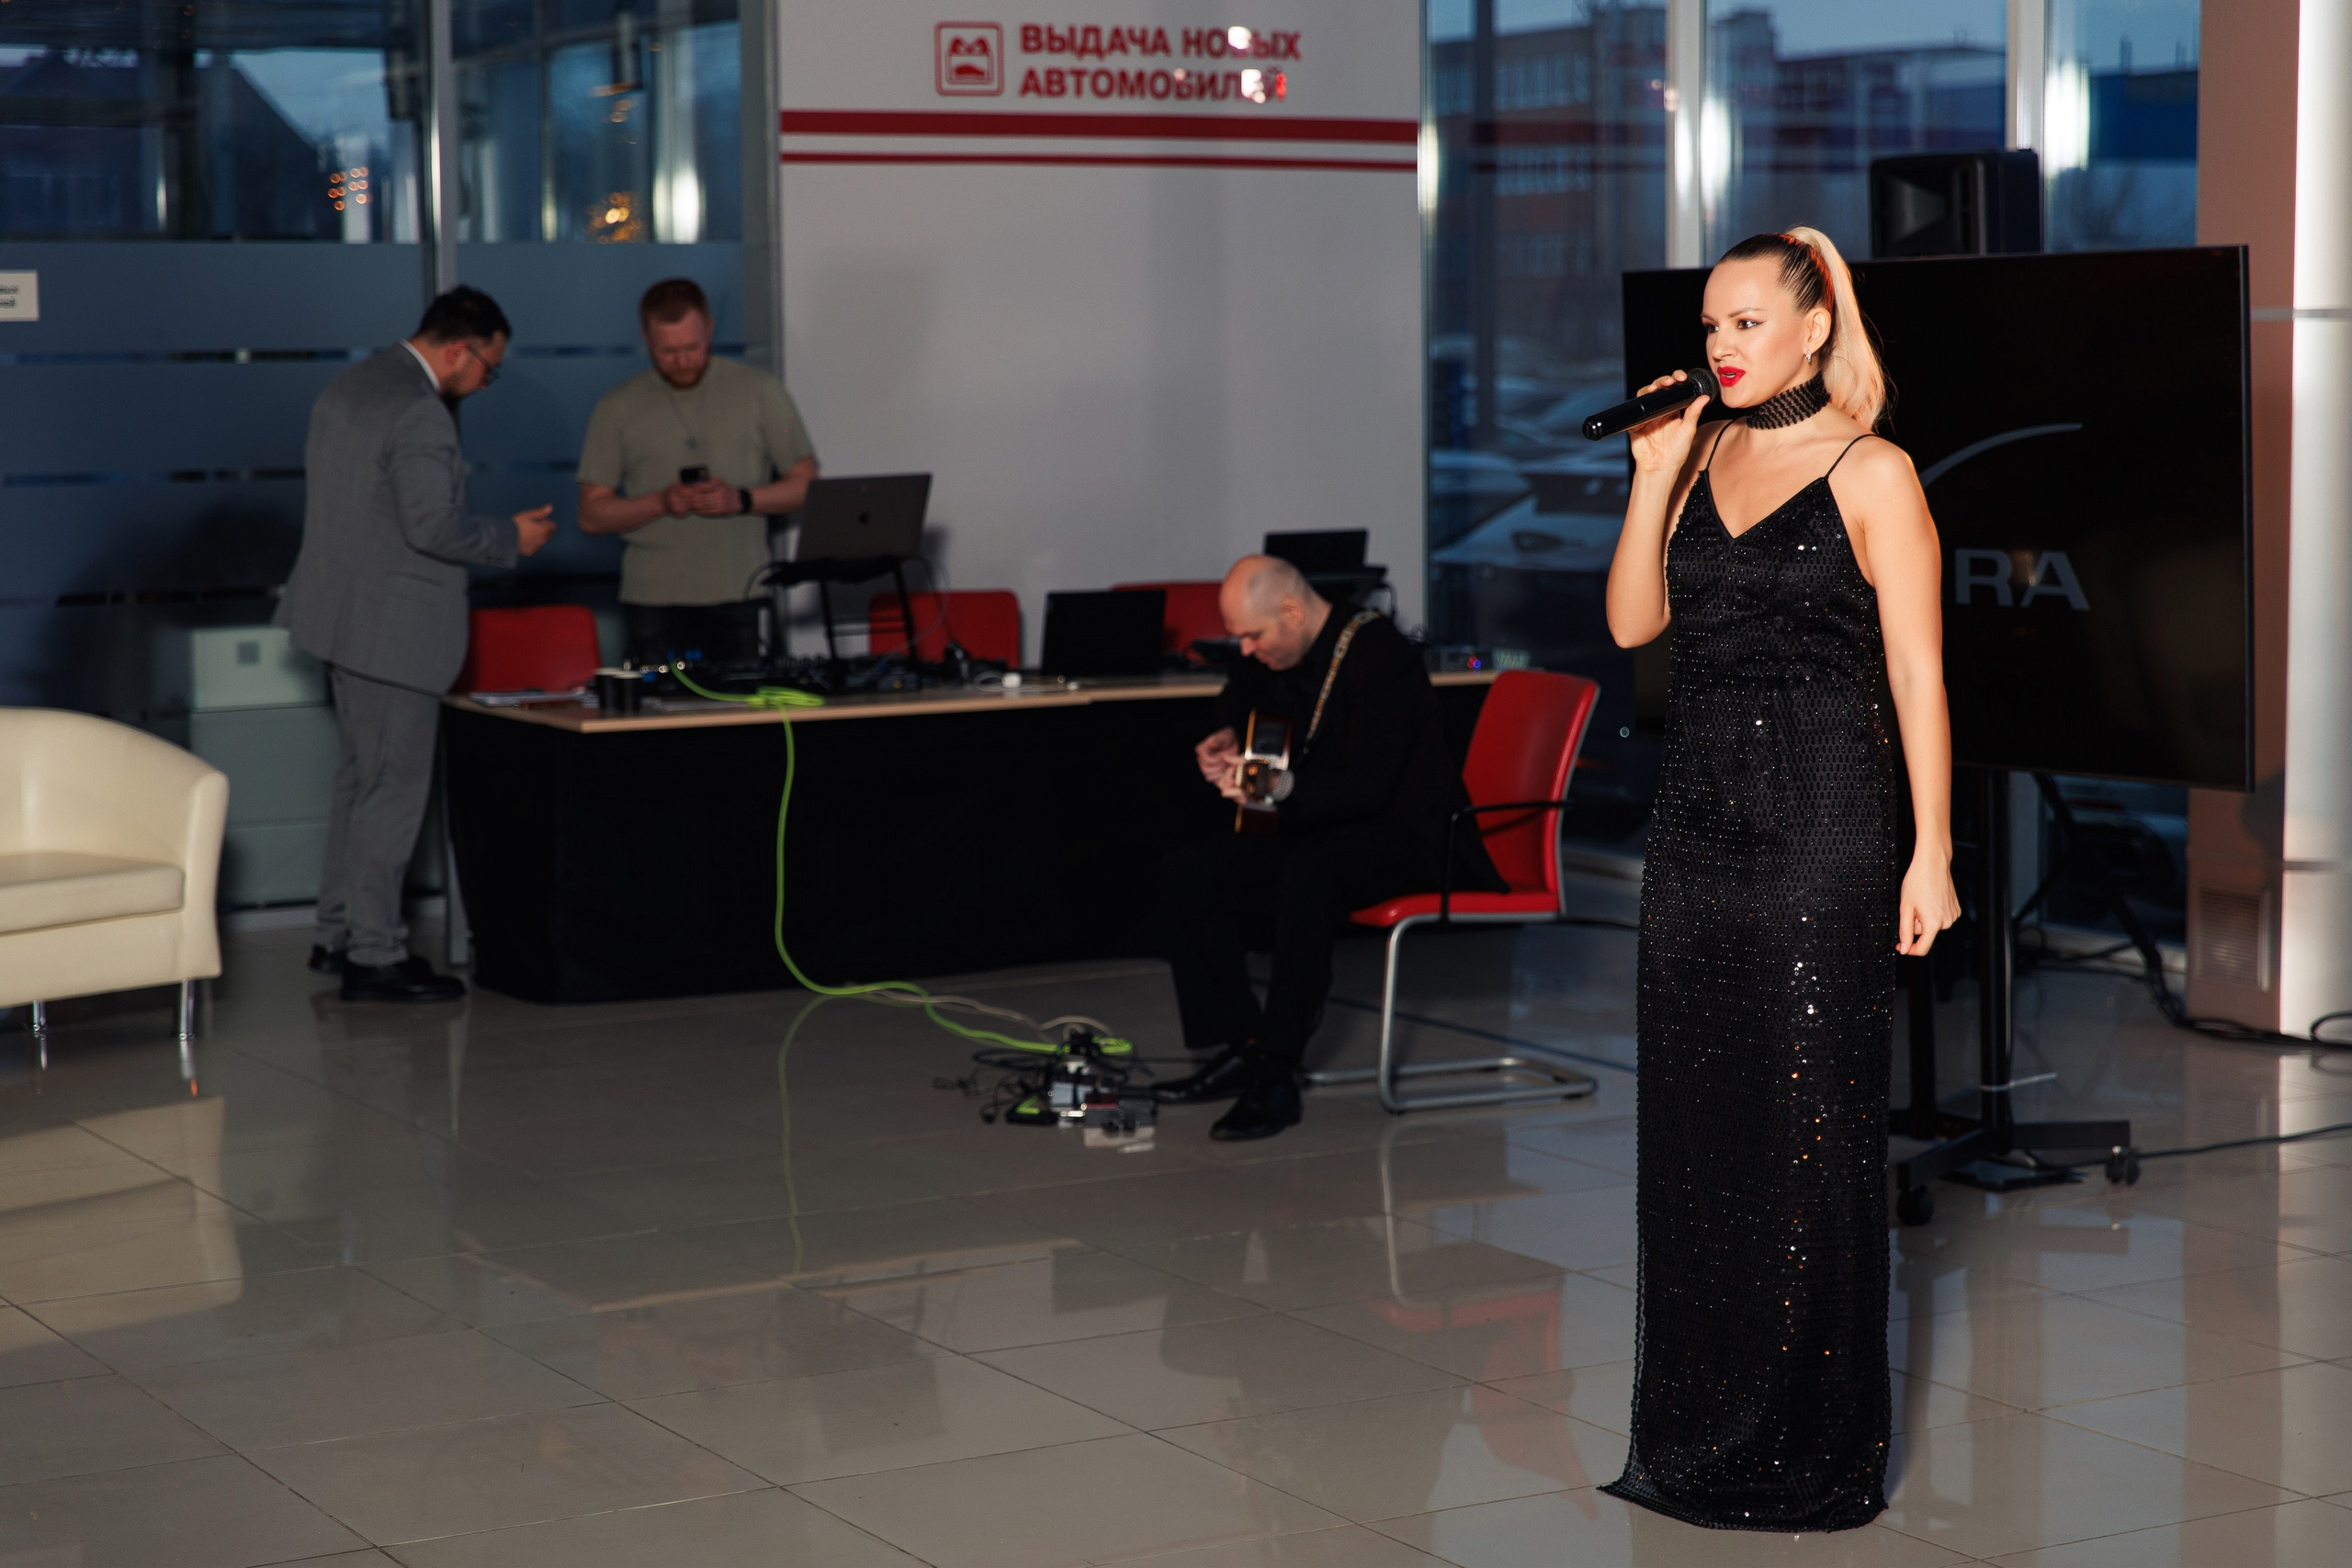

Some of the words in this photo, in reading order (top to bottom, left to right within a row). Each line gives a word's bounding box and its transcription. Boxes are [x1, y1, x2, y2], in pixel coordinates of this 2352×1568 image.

[1021, 23, 1171, 61] ВЫДАЧА
[1019, 66, 1286, 103] АВТОМОБИЛЙ
[1941, 548, 2090, 611] RA
